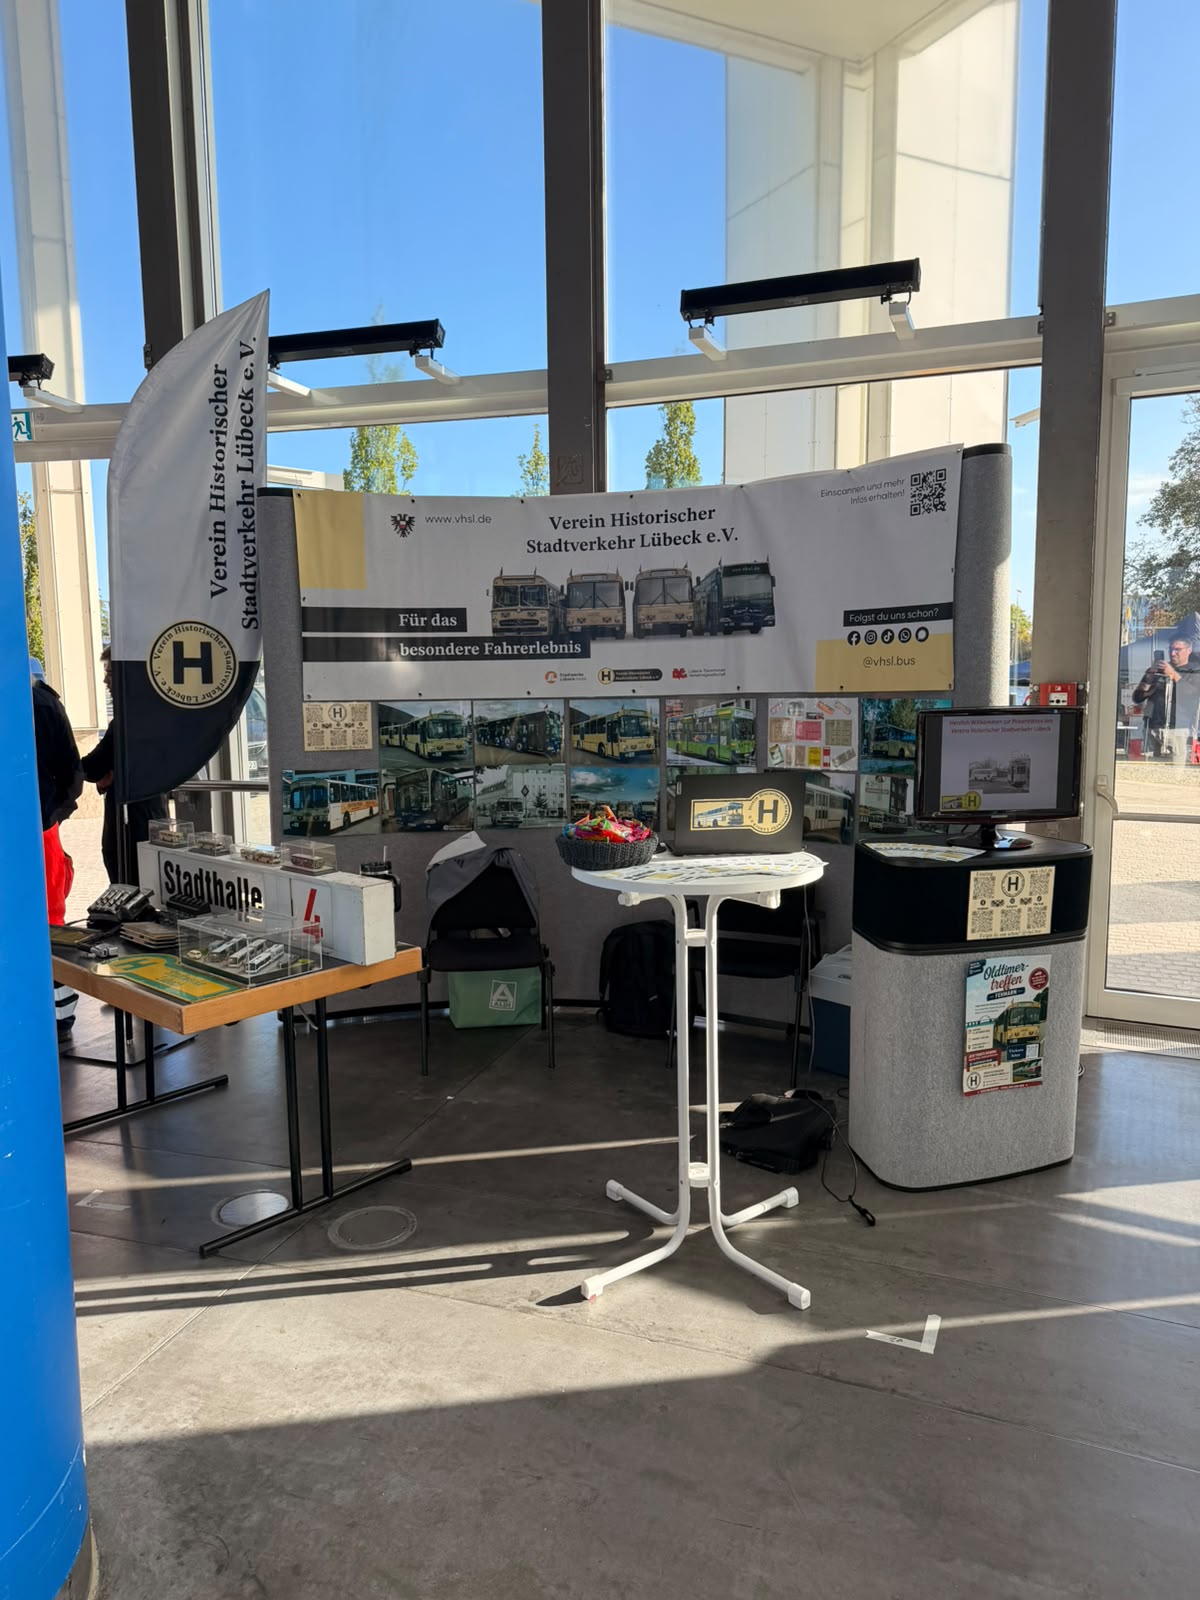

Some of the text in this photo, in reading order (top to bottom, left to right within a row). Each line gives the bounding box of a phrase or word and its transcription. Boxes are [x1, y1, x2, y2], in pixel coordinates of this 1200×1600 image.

[235, 387, 254, 473] Lübeck
[208, 364, 228, 599] Verein Historischer
[820, 478, 904, 497] Einscannen und mehr
[851, 489, 904, 504] Infos erhalten!
[425, 514, 492, 524] www.vhsl.de
[549, 507, 716, 530] Verein Historischer
[526, 527, 738, 553] Stadtverkehr Lübeck e.V.
[236, 480, 259, 630] Stadtverkehr
[399, 613, 457, 626] Für das
[849, 608, 939, 624] Folgst du uns schon?
[174, 625, 227, 650] Historischer
[153, 633, 173, 660] Verein
[400, 640, 581, 656] besondere Fahrerlebnis
[173, 641, 213, 684] H
[863, 656, 916, 668] @vhsl.bus
[201, 649, 232, 700] Stadtverkehr
[602, 671, 611, 681] H
[166, 685, 199, 702] Lübeck
[333, 708, 343, 718] H
[968, 796, 976, 807] H
[758, 800, 779, 823] H
[164, 860, 264, 912] Stadthalle
[1008, 876, 1019, 891] H
[983, 962, 1029, 980] Oldtimer-
[990, 974, 1023, 991] treffen
[970, 1076, 977, 1087] H
